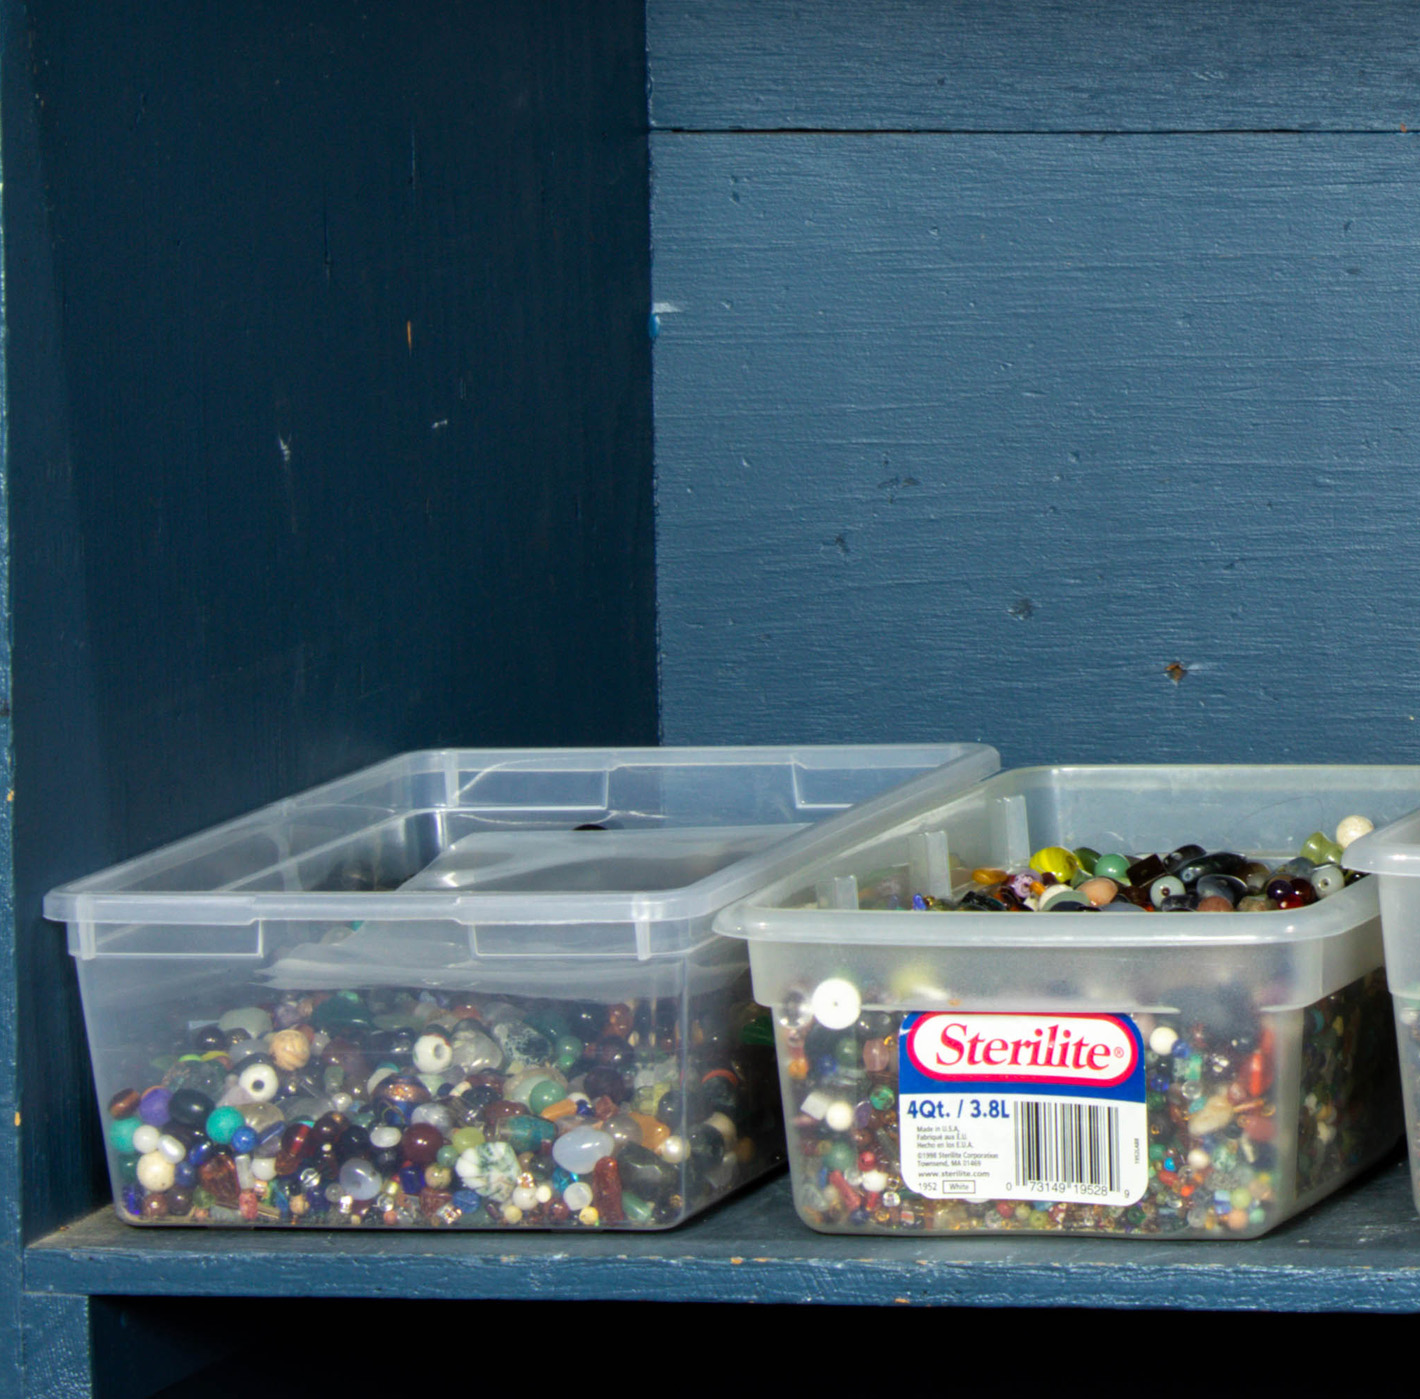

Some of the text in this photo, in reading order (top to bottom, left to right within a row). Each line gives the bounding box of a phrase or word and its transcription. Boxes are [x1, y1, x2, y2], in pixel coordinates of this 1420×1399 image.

[936, 1022, 1111, 1071] Sterilite
[906, 1099, 1010, 1119] 4Qt. / 3.8L
[963, 1152, 998, 1160] Corporation
[918, 1182, 937, 1191] 1952
[1006, 1182, 1130, 1198] 0 73149 19528 9
